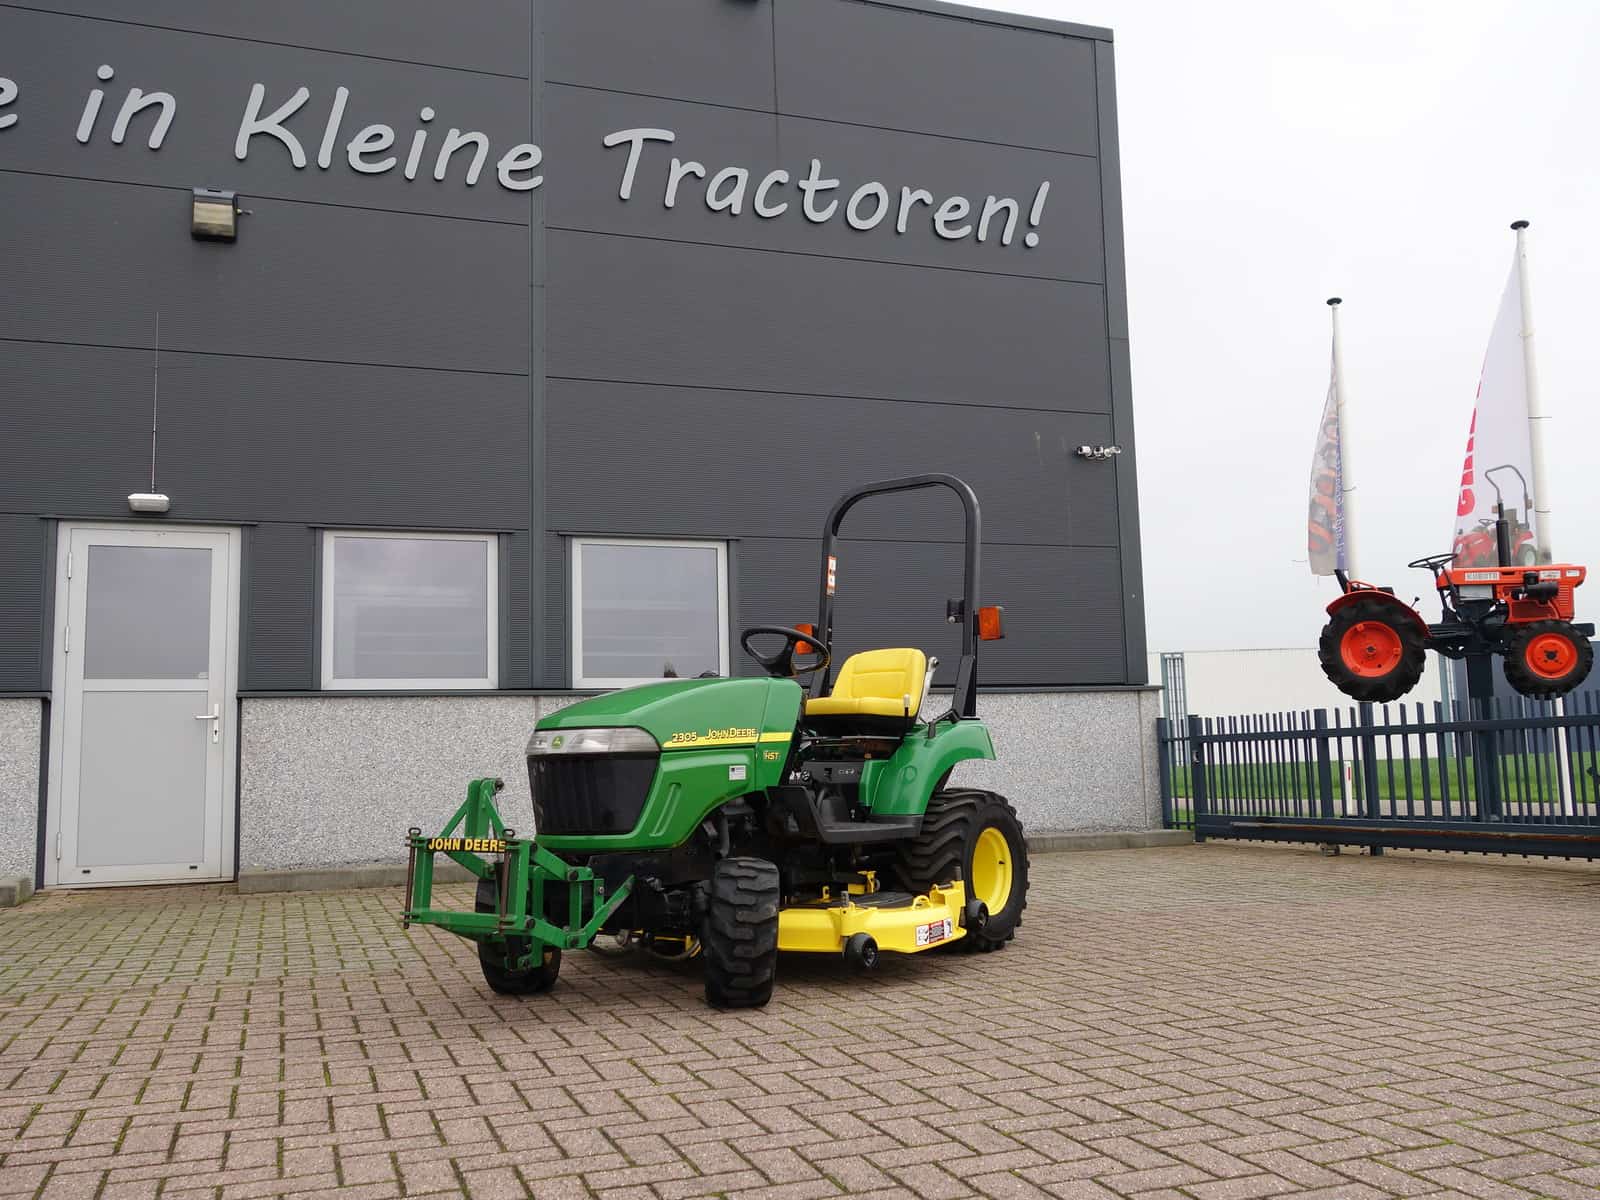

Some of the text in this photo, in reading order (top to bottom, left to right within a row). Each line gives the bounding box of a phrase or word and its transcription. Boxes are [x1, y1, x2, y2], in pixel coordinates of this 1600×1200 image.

[76, 65, 176, 149] in
[234, 83, 545, 191] Kleine
[603, 127, 1051, 248] Tractoren!
[671, 727, 758, 743] 2305 JOHN DEERE
[428, 838, 507, 852] JOHN DEERE
